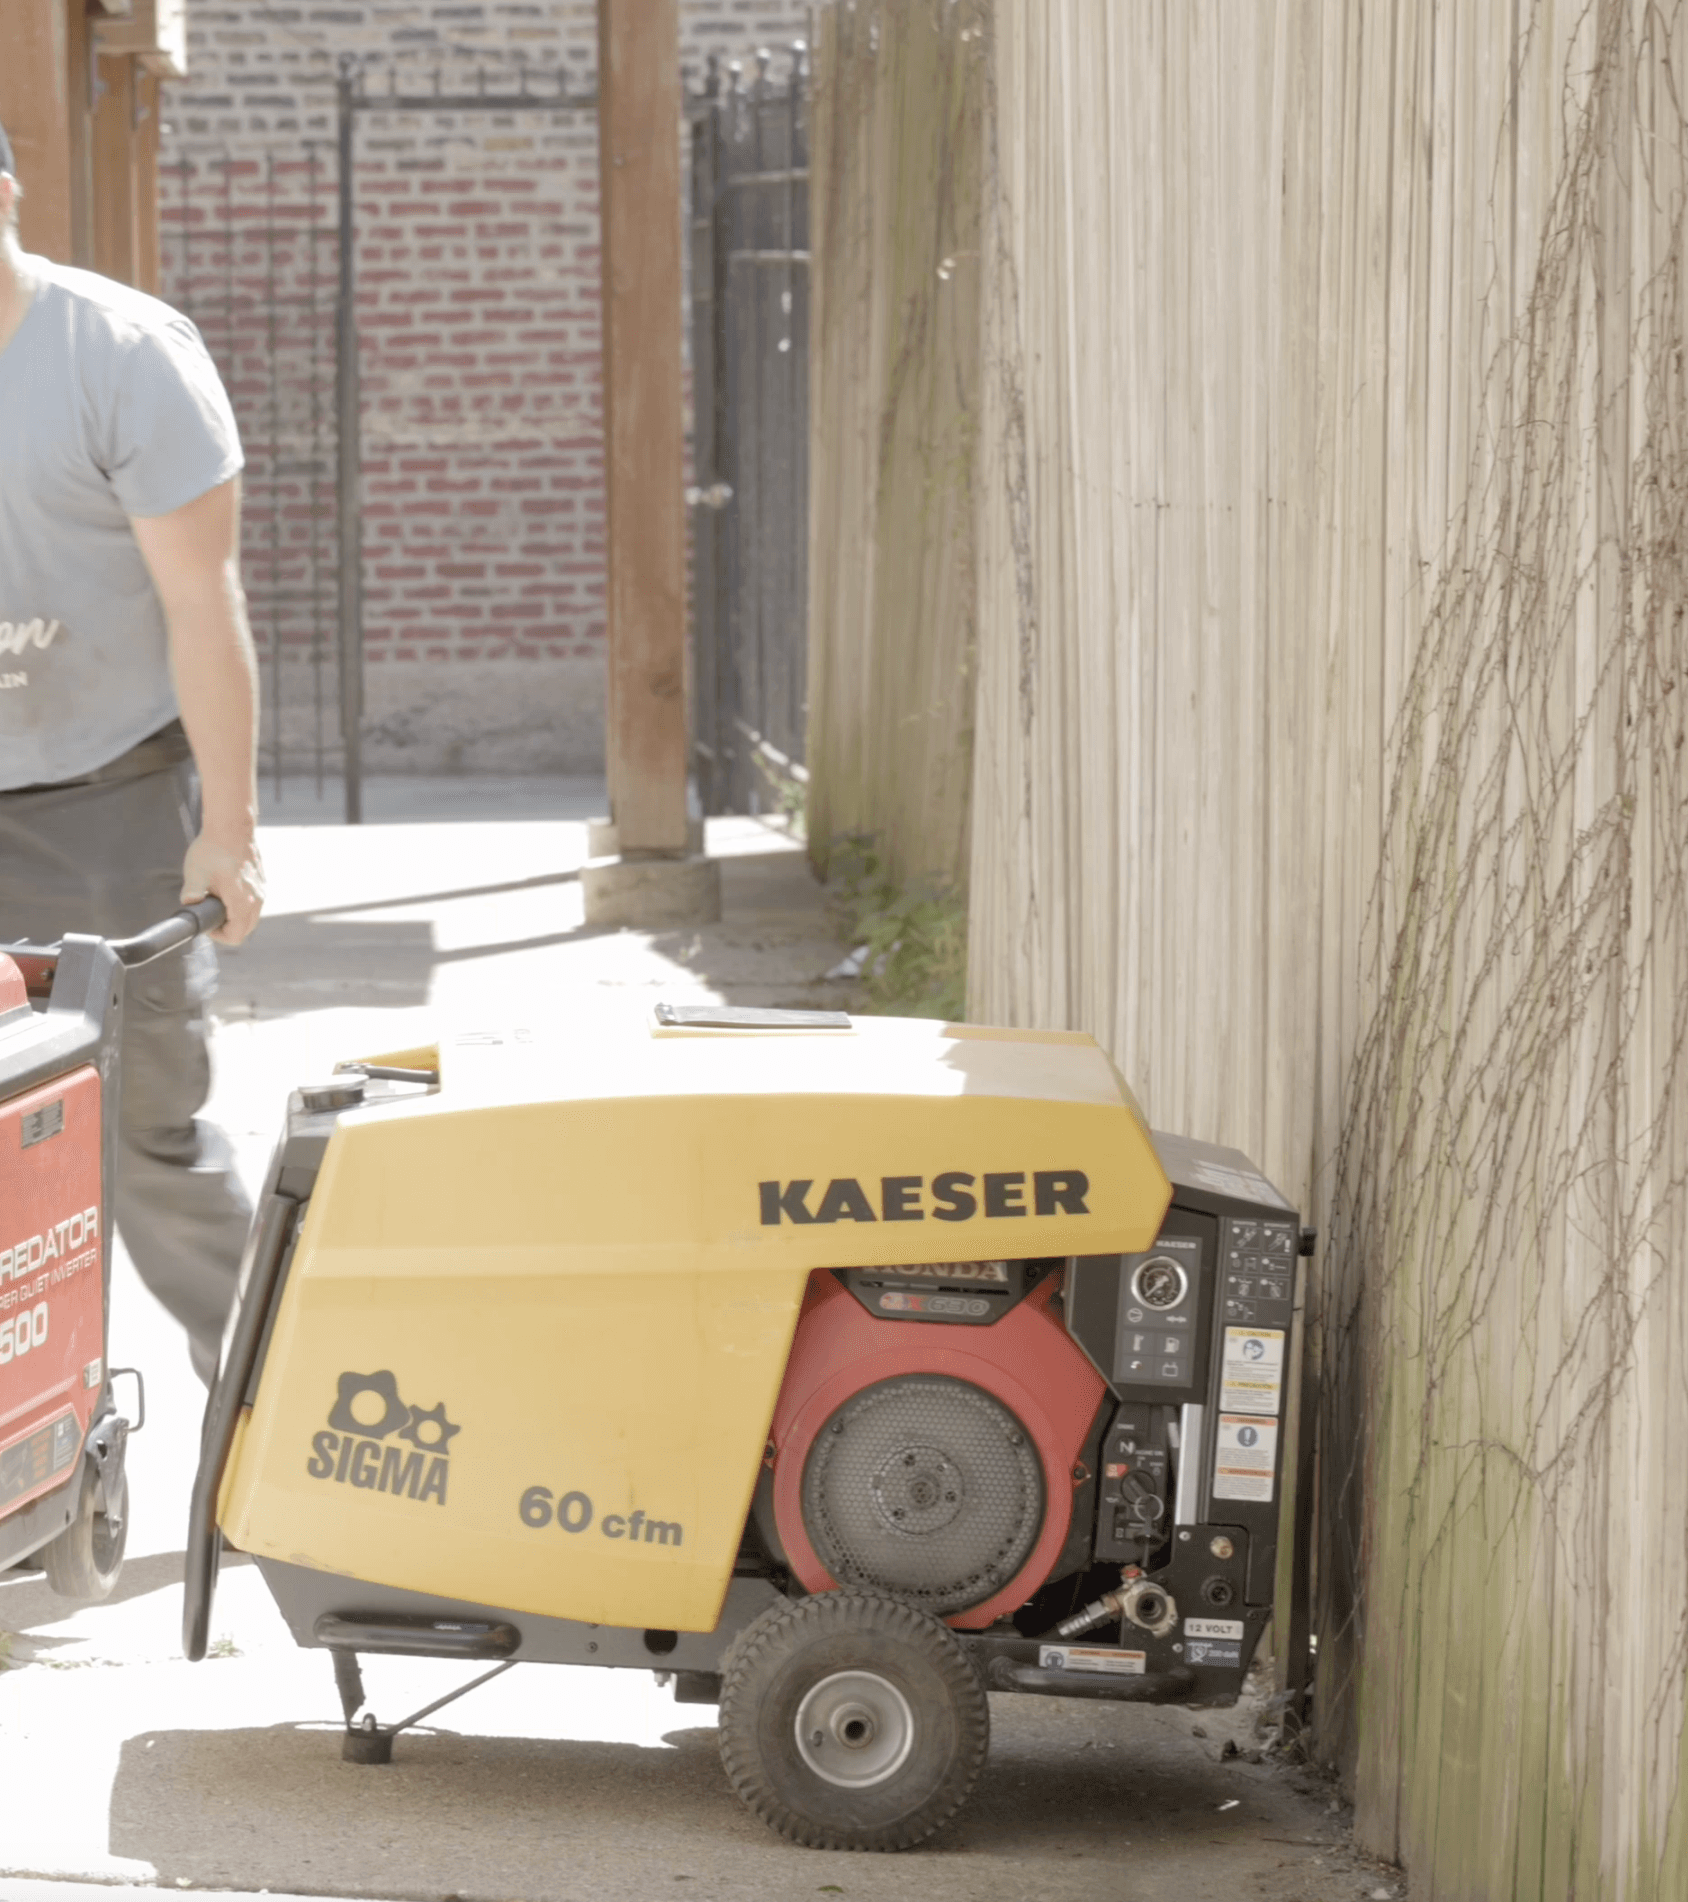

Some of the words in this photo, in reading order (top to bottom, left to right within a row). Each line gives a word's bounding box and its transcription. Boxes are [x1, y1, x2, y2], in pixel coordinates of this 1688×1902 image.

[758, 1169, 1091, 1225] KAESER
[20, 1272, 50, 1302] QUIET
[50, 1247, 98, 1287] INVERTER
[307, 1430, 450, 1506] SIGMA
[519, 1486, 593, 1534] 60
[601, 1510, 683, 1547] cfm
[1189, 1624, 1202, 1632] 12
[1205, 1624, 1233, 1634] VOLT
